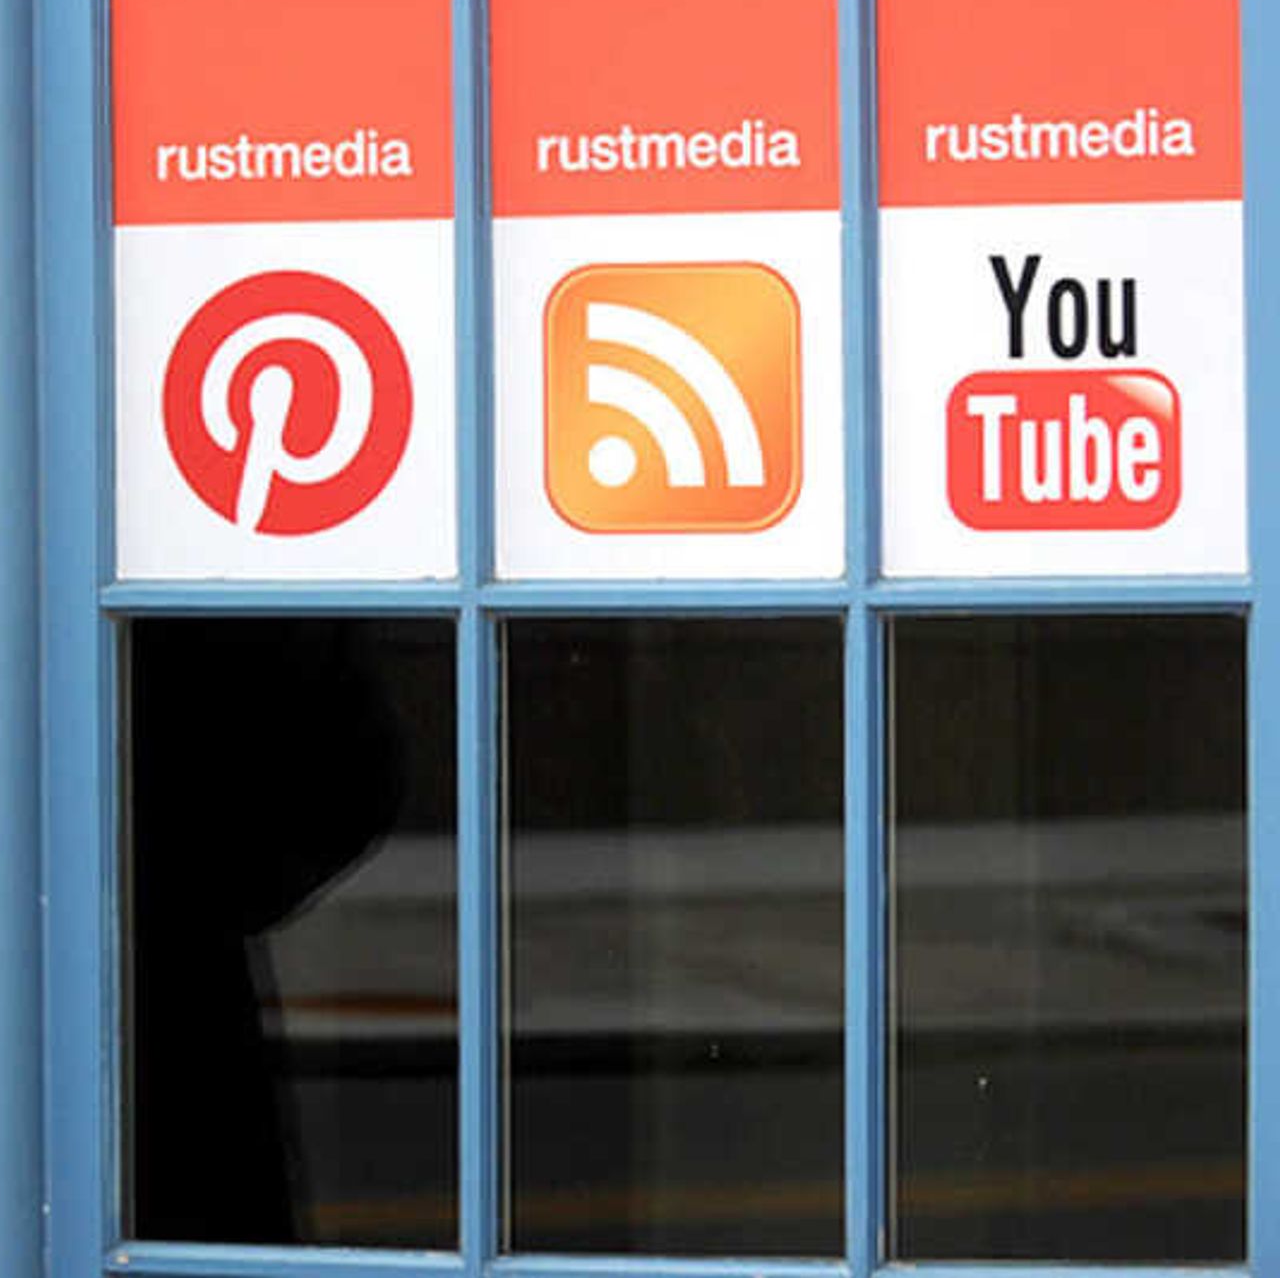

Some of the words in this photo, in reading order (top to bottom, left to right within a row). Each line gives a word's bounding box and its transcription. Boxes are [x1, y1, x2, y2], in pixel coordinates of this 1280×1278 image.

[157, 128, 412, 181] rustmedia
[537, 118, 801, 172] rustmedia
[926, 106, 1195, 162] rustmedia
[989, 254, 1137, 360] You
[966, 393, 1162, 503] Tube
